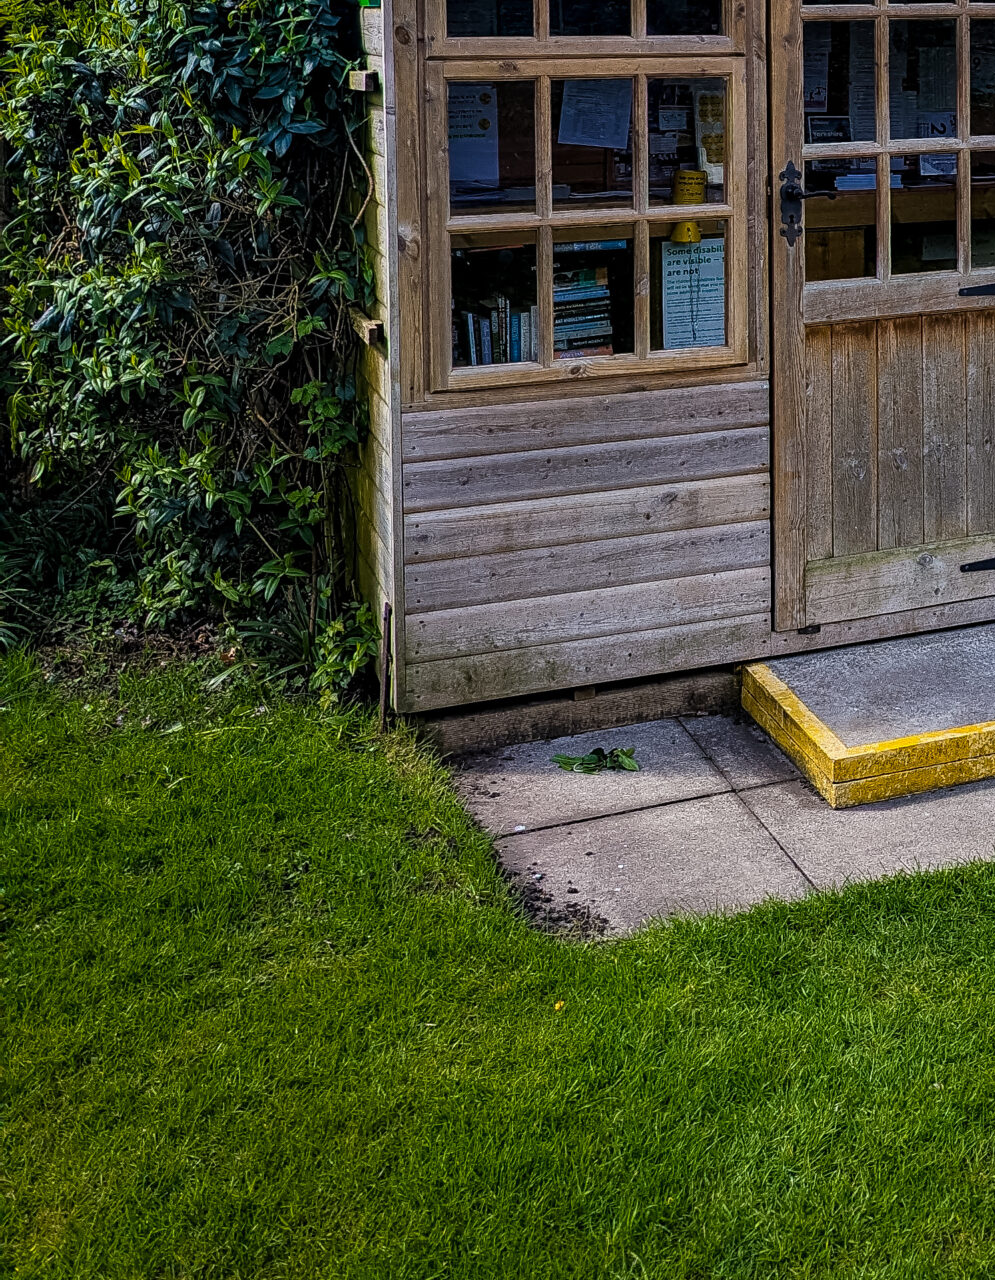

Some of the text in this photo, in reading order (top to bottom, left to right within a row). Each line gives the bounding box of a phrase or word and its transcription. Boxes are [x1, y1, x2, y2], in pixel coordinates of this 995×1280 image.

[931, 122, 946, 135] 2
[667, 248, 692, 256] Some
[683, 256, 711, 265] visible
[683, 267, 699, 275] not
